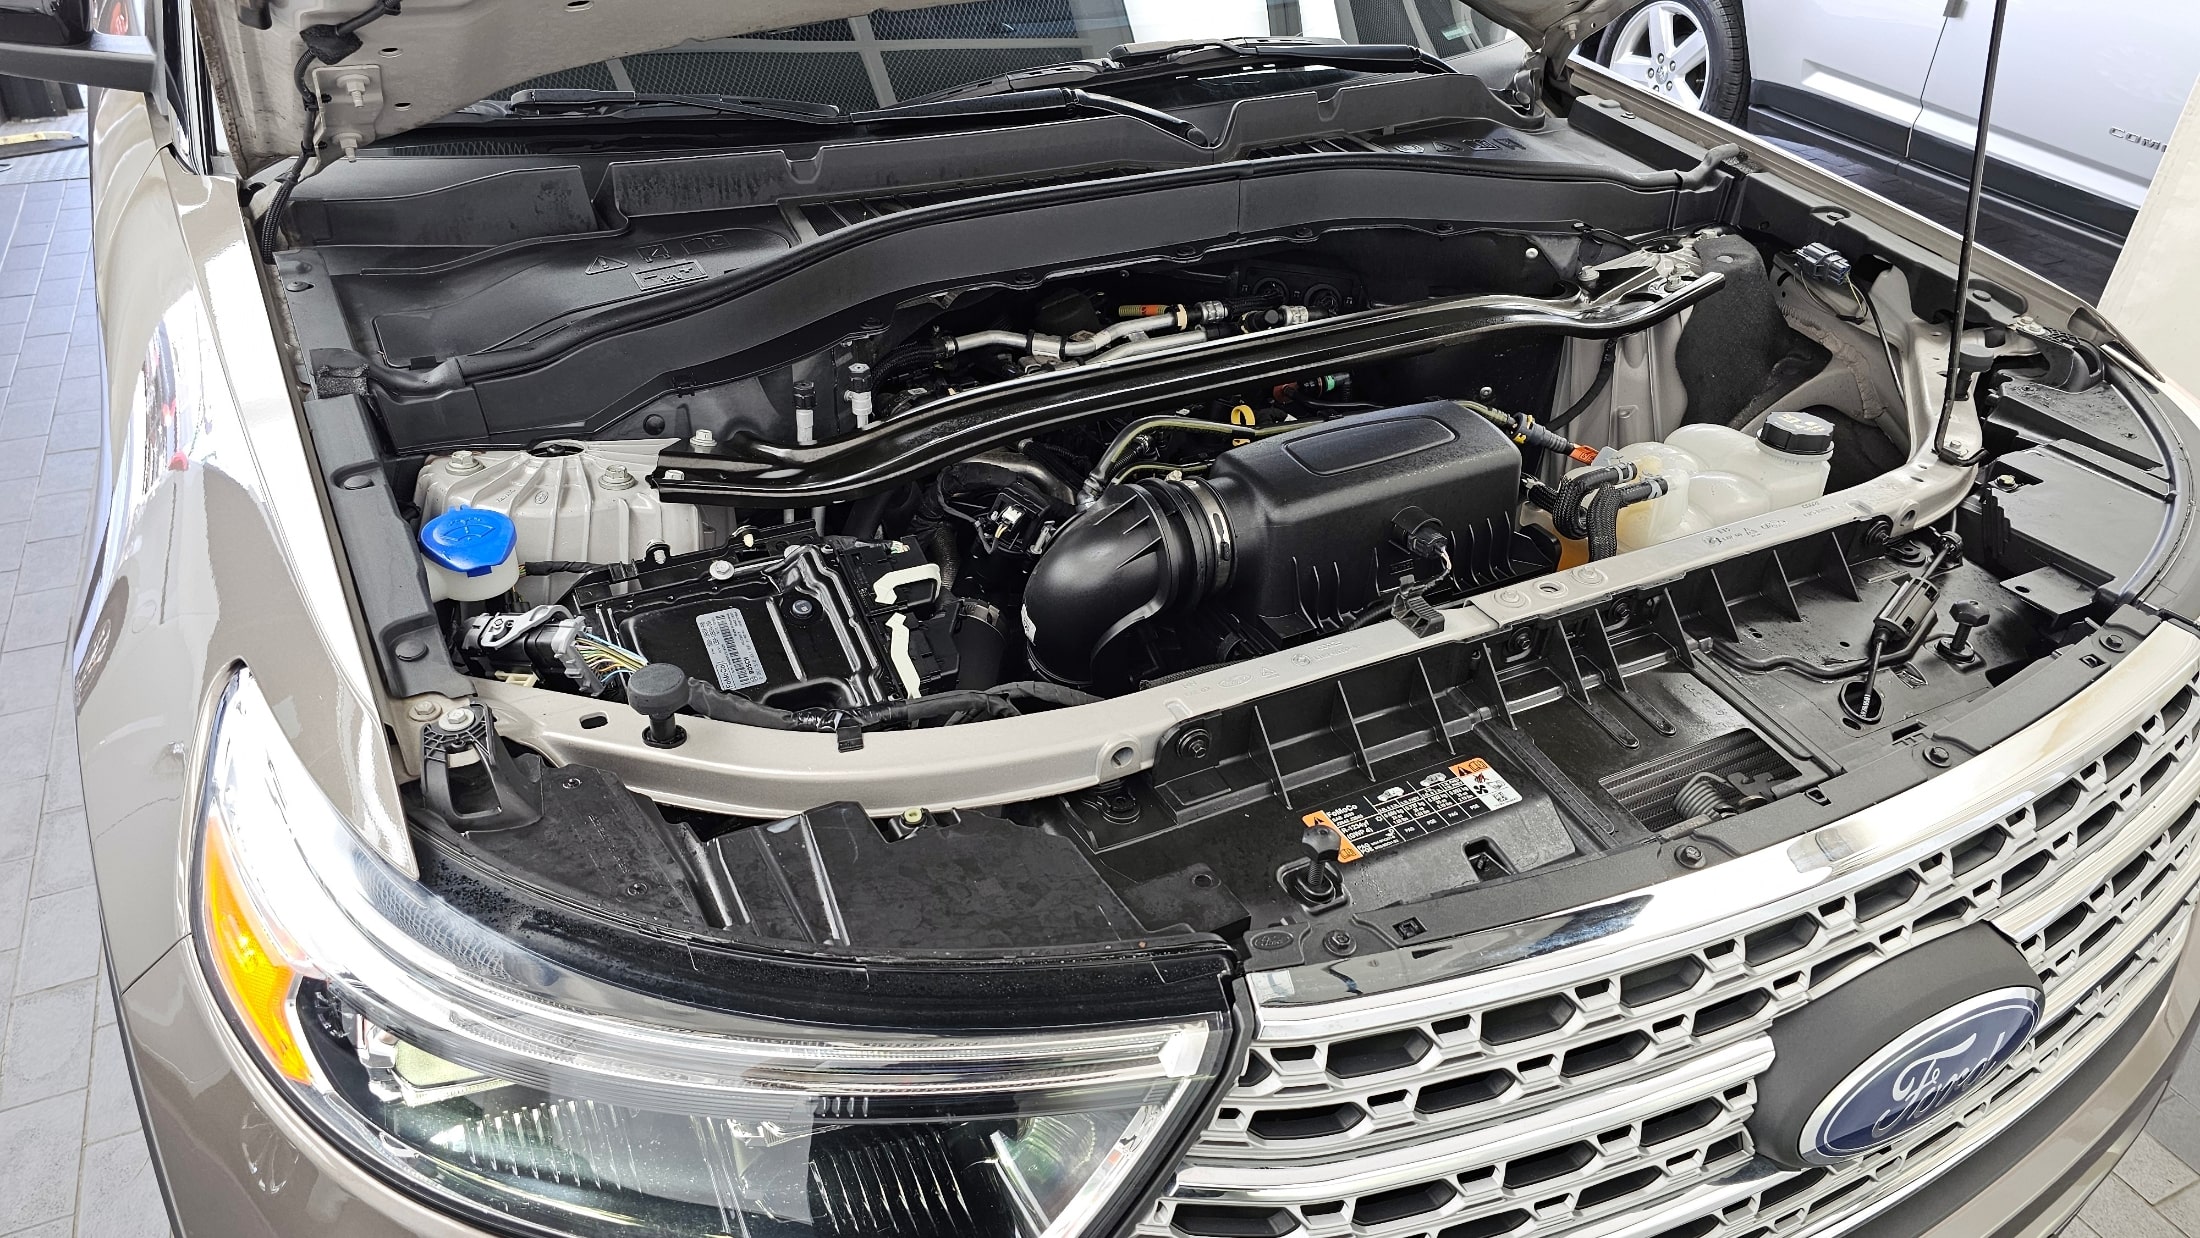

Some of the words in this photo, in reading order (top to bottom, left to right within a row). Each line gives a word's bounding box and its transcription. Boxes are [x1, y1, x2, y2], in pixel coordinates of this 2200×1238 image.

[1326, 805, 1358, 818] FoMoCo
[1341, 820, 1369, 833] R-1234yf
[1347, 830, 1365, 840] (GWP
[1872, 1032, 2005, 1138] Ford
